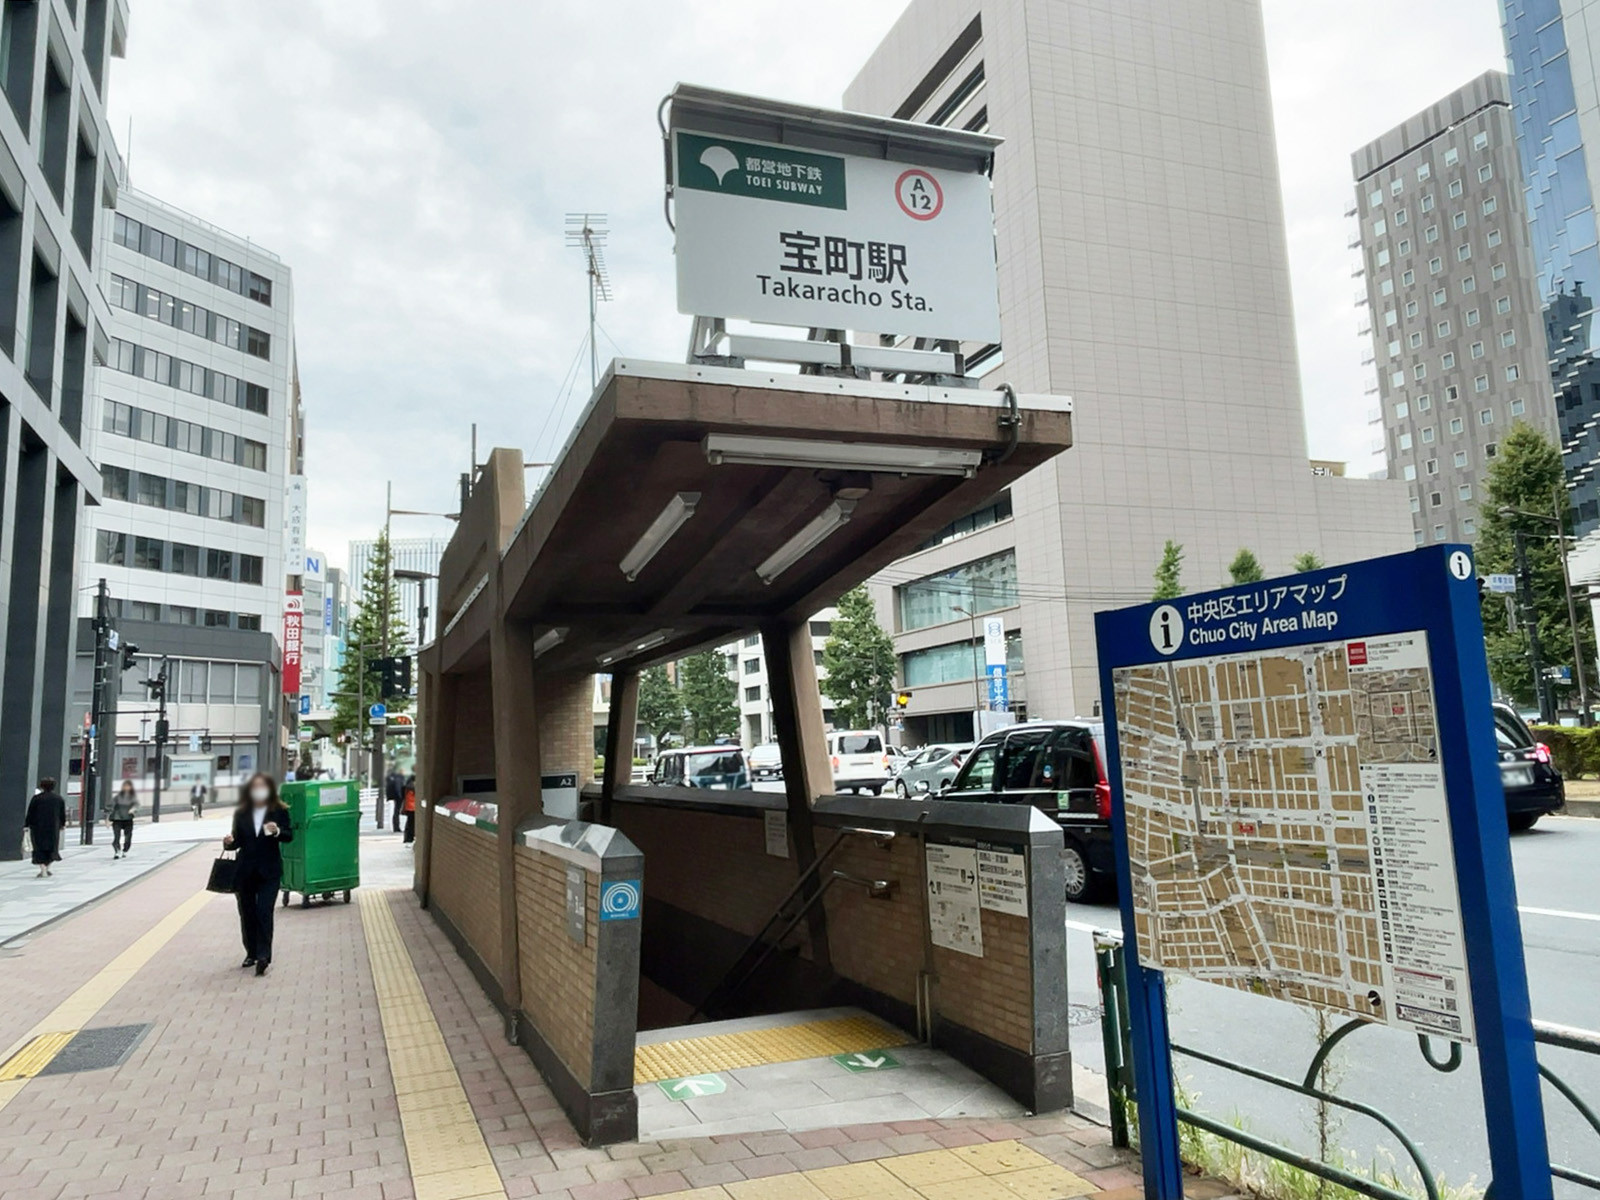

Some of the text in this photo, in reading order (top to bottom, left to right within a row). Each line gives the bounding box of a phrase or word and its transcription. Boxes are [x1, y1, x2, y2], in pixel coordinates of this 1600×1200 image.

[745, 157, 822, 180] 都営地下鉄
[745, 174, 823, 195] TOEI SUBWAY
[912, 178, 925, 193] A
[909, 193, 932, 210] 12
[779, 230, 909, 286] 宝町駅
[756, 275, 934, 313] Takaracho Sta.
[1187, 573, 1348, 624] 中央区エリアマップ
[285, 614, 301, 666] 秋田銀行
[1189, 610, 1338, 645] Chuo City Area Map
[560, 778, 572, 786] A2
